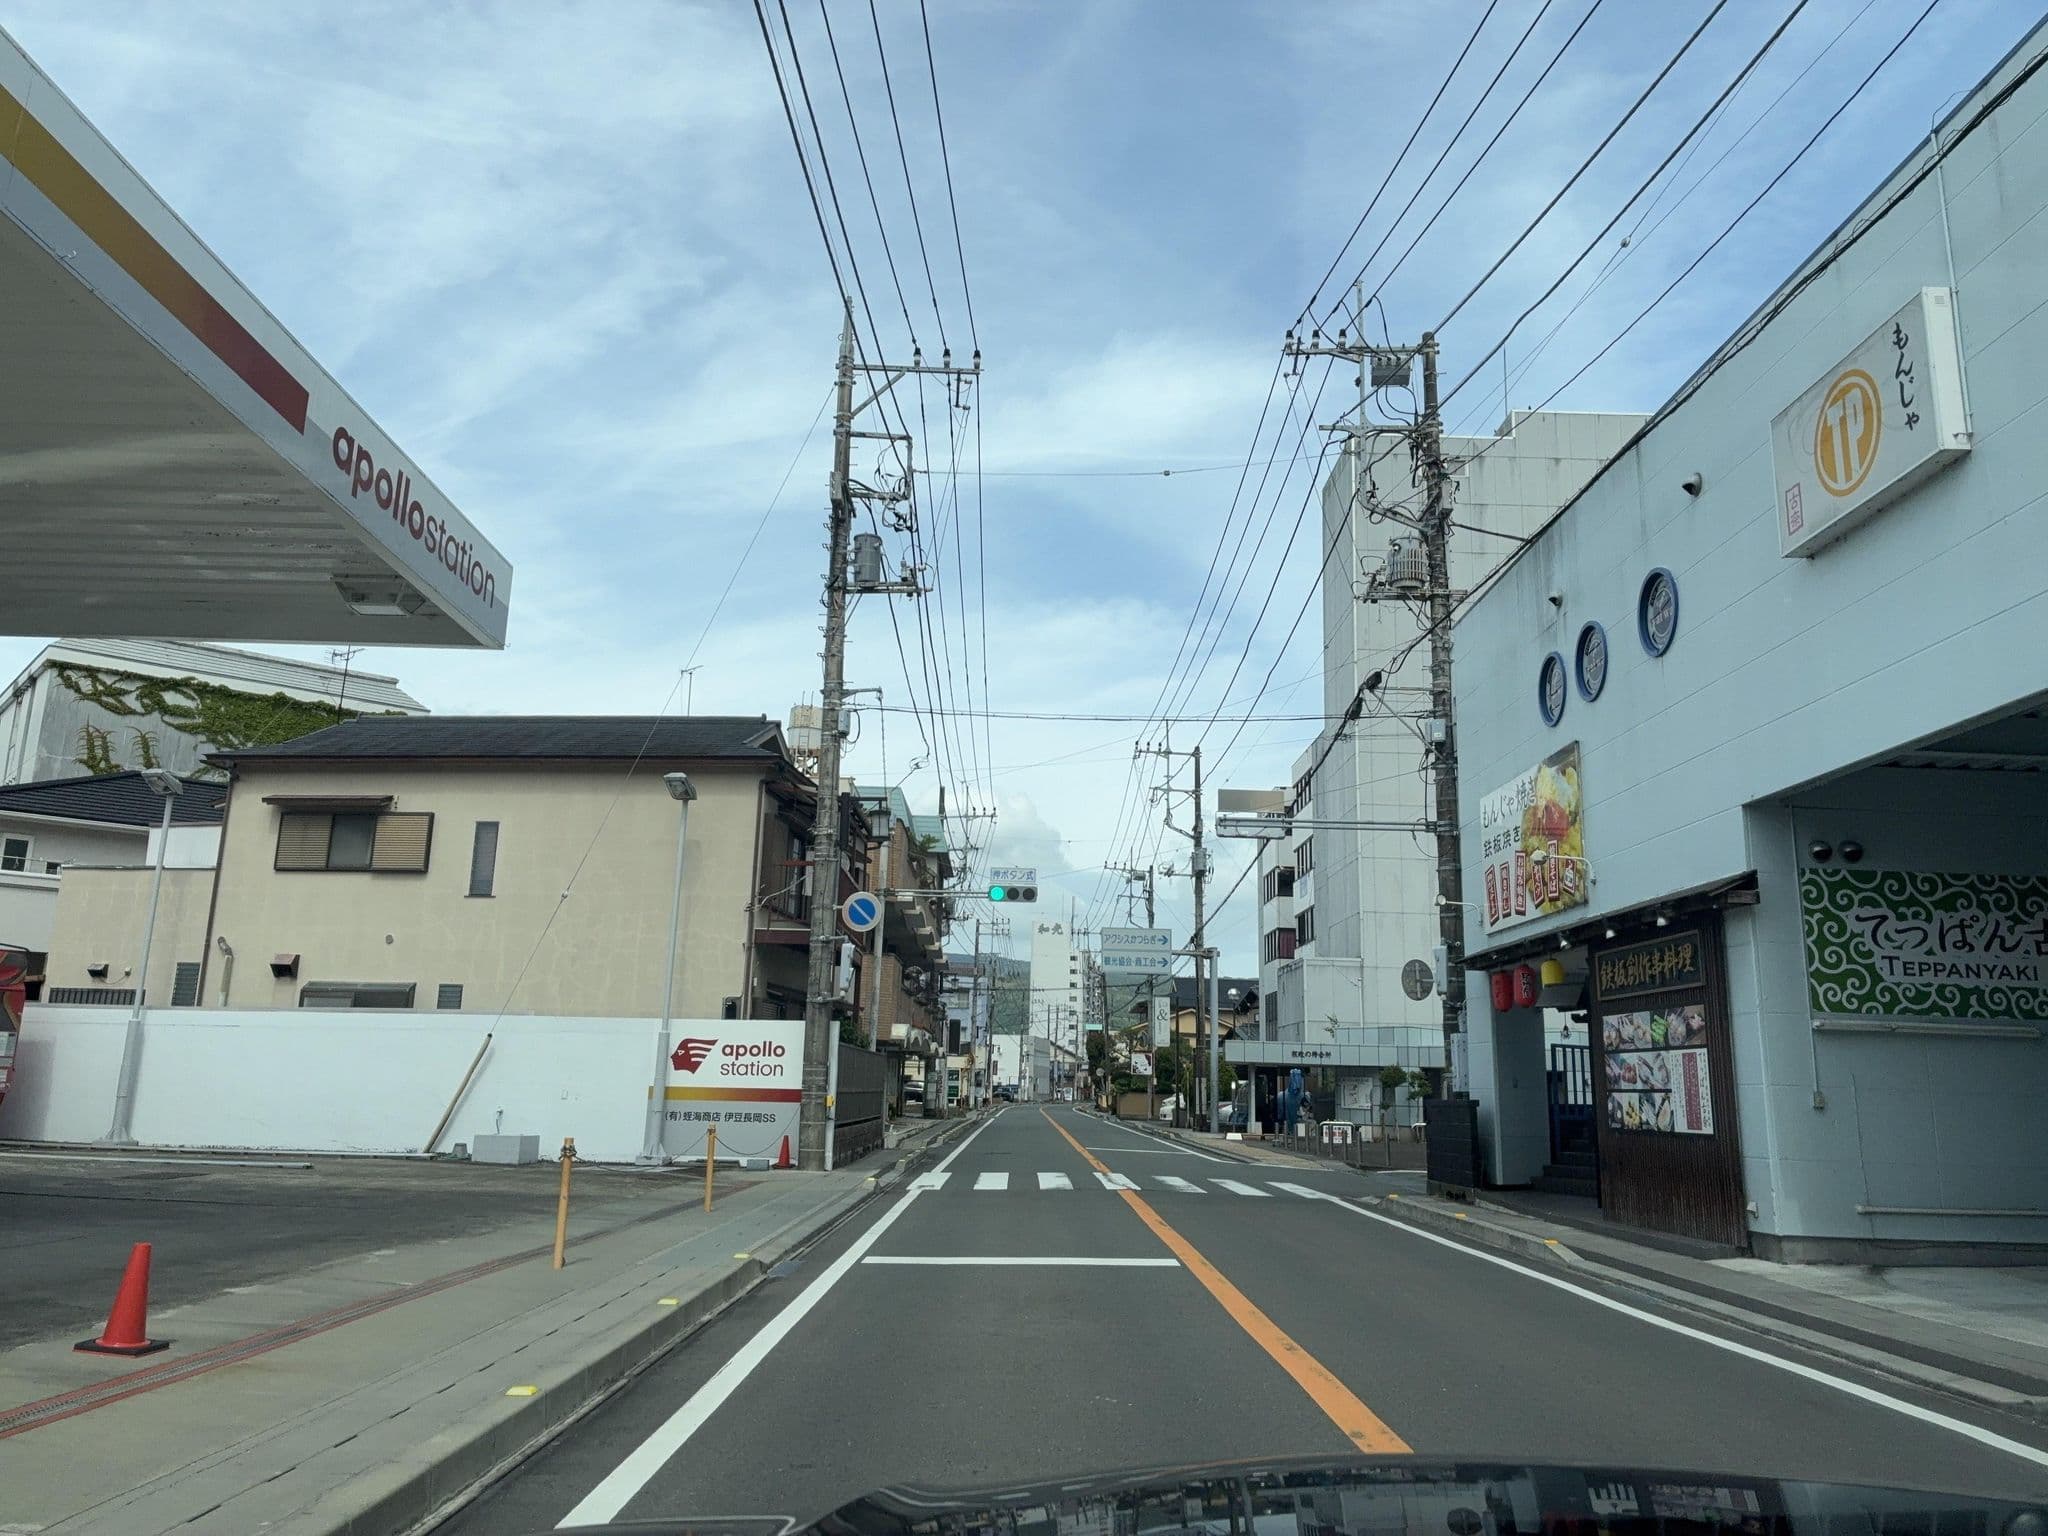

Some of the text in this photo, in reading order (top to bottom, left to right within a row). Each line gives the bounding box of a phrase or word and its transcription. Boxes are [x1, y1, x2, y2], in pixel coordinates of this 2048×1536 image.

[1892, 323, 1920, 431] もんじゃ
[1483, 776, 1537, 829] もんじゃ焼き
[992, 870, 1034, 881] 押ボタン式
[1104, 934, 1156, 945] アクシスかつらぎ
[1881, 956, 2039, 982] TEPPANYAKI
[722, 1041, 785, 1060] apollo
[720, 1061, 784, 1077] station
[724, 1112, 776, 1123] 伊豆長岡SS
